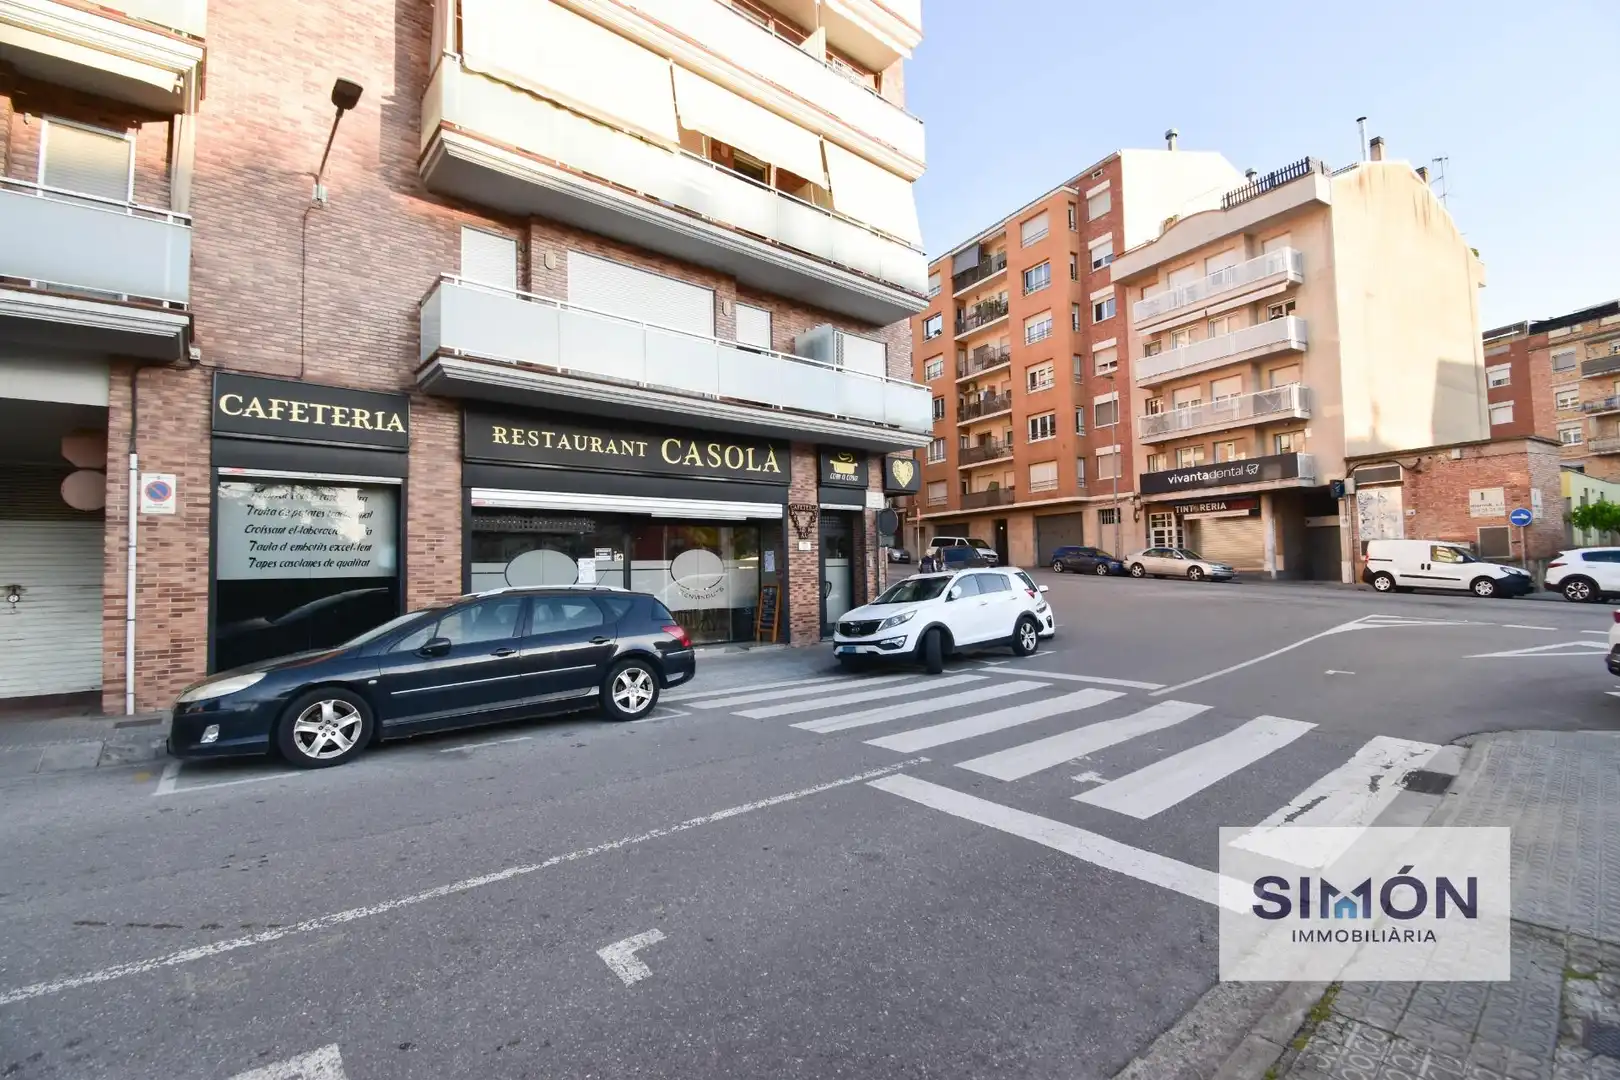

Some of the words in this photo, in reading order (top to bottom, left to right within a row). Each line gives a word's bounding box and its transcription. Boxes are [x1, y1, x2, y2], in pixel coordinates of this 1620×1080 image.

[219, 393, 406, 433] CAFETERIA
[492, 425, 648, 457] RESTAURANT
[661, 438, 781, 473] CASOLÀ
[1168, 465, 1244, 485] vivantadental
[246, 504, 277, 516] Truita
[244, 524, 287, 535] Croissant
[250, 540, 279, 552] Taula
[249, 556, 278, 570] Tapes
[280, 558, 321, 568] casolanes
[323, 558, 334, 568] de
[336, 558, 371, 570] qualitat
